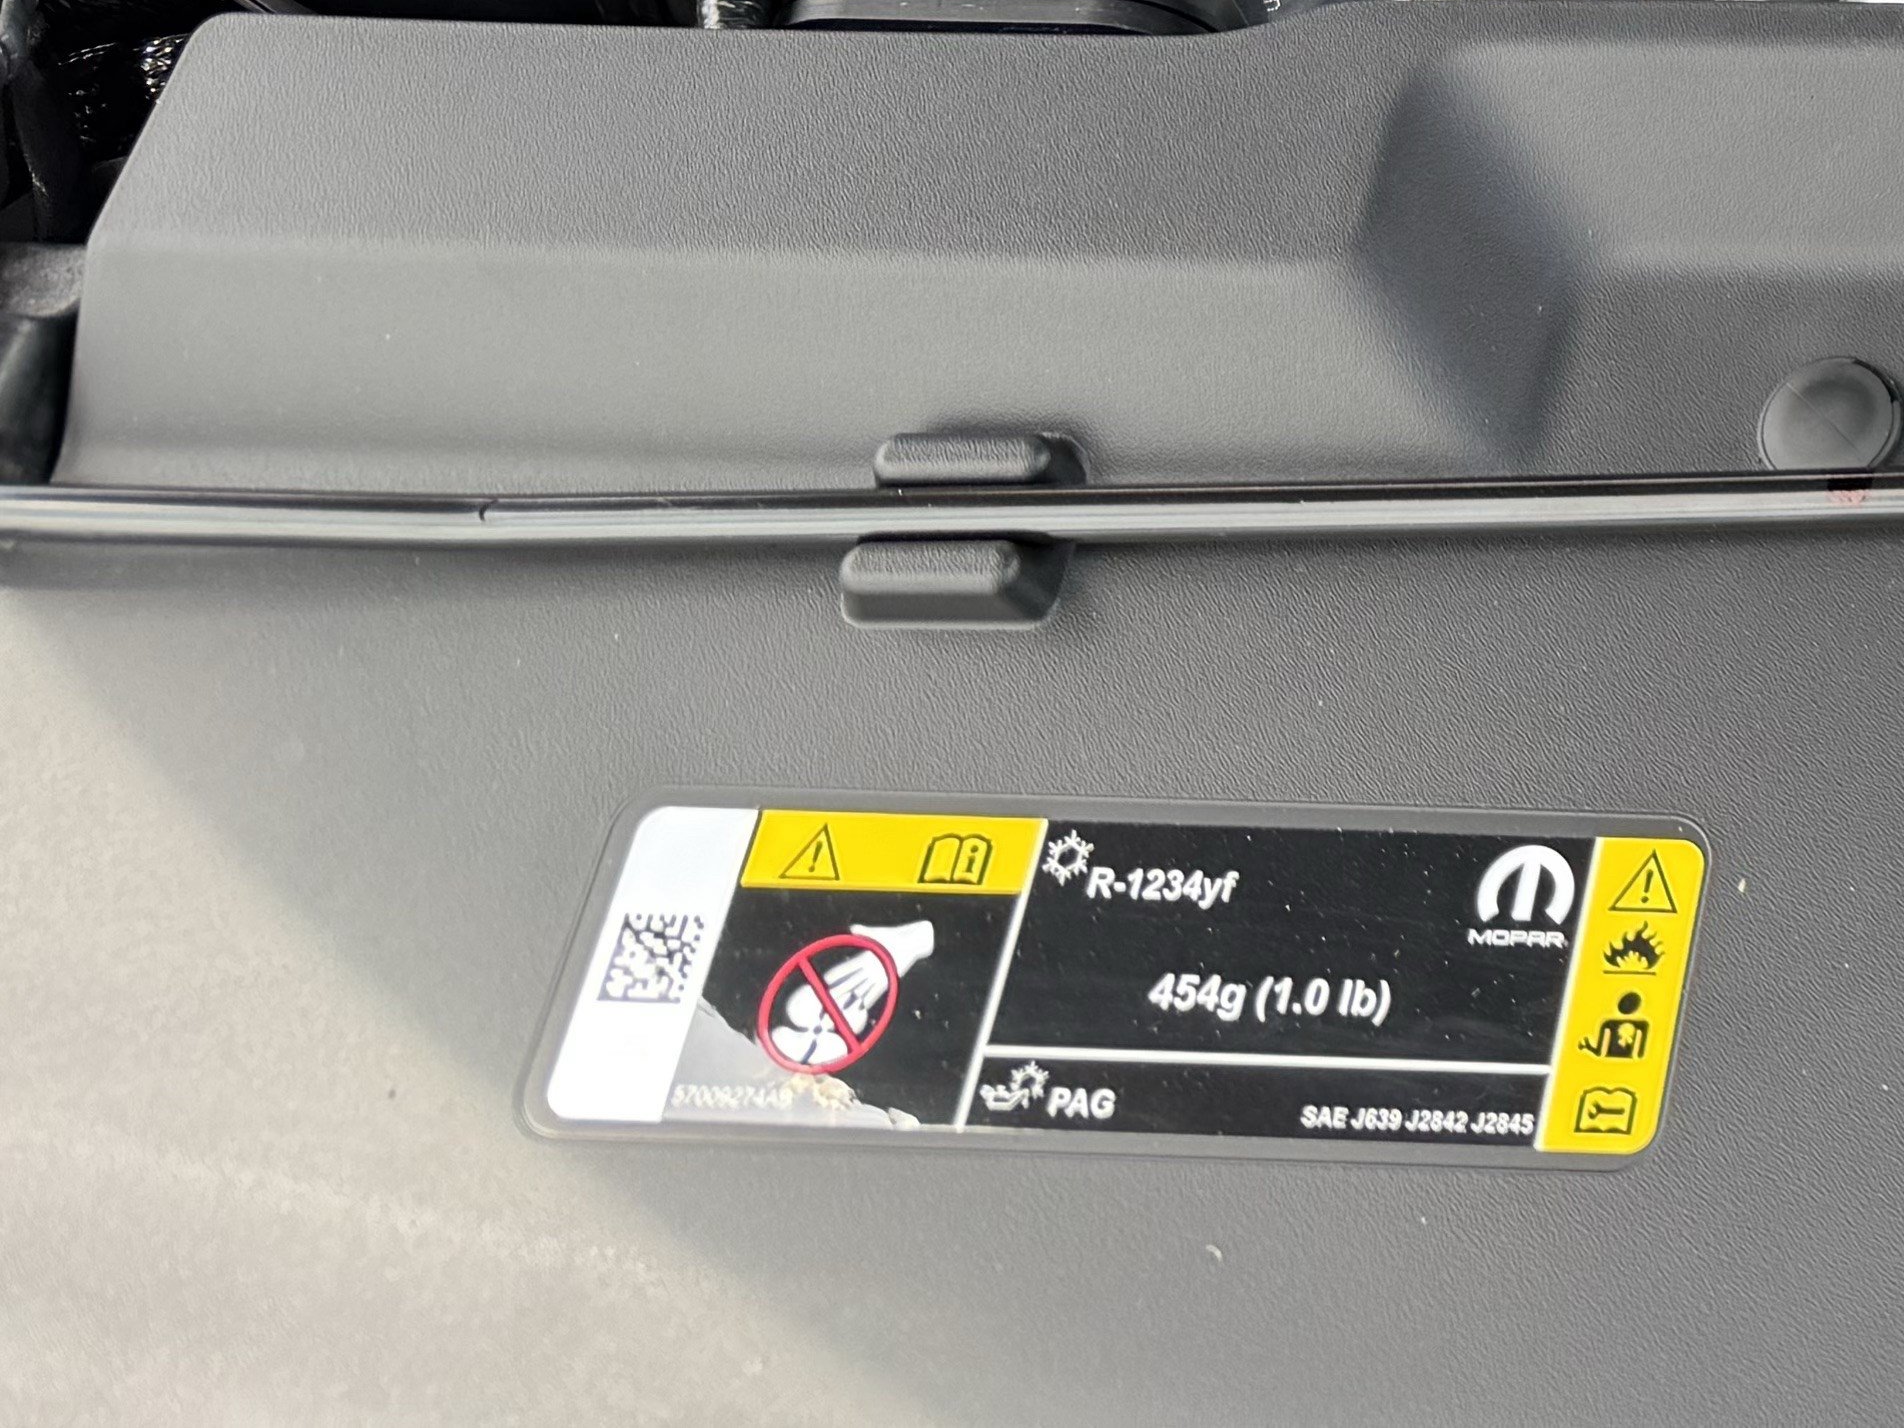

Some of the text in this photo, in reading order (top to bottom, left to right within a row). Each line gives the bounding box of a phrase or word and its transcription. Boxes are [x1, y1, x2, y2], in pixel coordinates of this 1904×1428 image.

[1086, 866, 1239, 906] R-1234yf
[1467, 926, 1565, 948] MOPAR
[1147, 972, 1391, 1026] 454g (1.0 lb)
[1047, 1086, 1116, 1121] PAG
[1299, 1104, 1535, 1137] SAE J639 J2842 J2845
